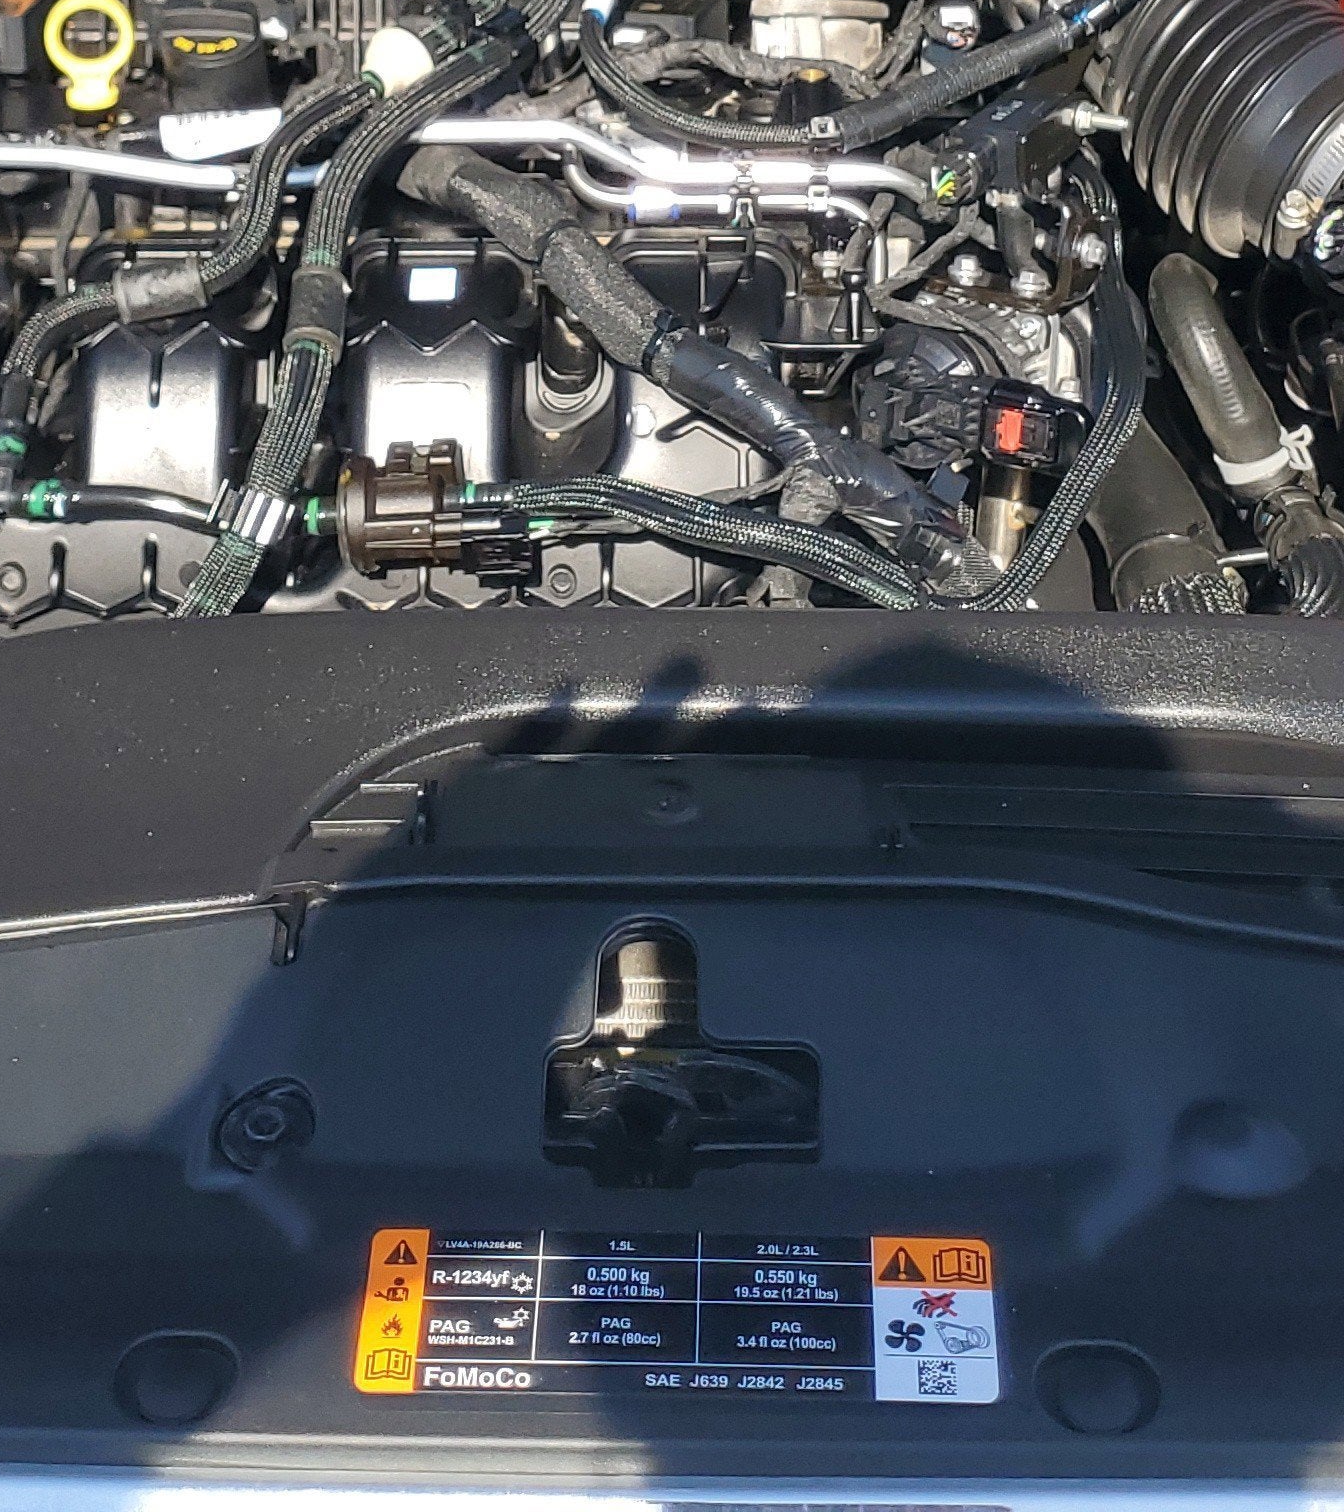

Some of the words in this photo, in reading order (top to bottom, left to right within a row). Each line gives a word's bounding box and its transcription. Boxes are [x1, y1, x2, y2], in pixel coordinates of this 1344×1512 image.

[608, 1240, 637, 1251] 1.5L
[756, 1244, 784, 1255] 2.0L
[792, 1245, 819, 1256] 2.3L
[432, 1269, 511, 1288] R-1234yf
[587, 1267, 627, 1282] 0.500
[631, 1268, 650, 1285] kg
[754, 1269, 795, 1284] 0.550
[798, 1270, 817, 1288] kg
[570, 1284, 586, 1296] 18
[588, 1287, 605, 1296] oz
[607, 1284, 638, 1298] (1.10
[640, 1286, 665, 1299] lbs)
[734, 1286, 760, 1298] 19.5
[763, 1289, 779, 1299] oz
[781, 1287, 811, 1301] (1.21
[815, 1288, 839, 1302] lbs)
[429, 1319, 471, 1334] PAG
[601, 1317, 632, 1329] PAG
[771, 1321, 802, 1334] PAG
[427, 1335, 515, 1346] WSH-M1C231-B
[568, 1331, 589, 1344] 2.7
[591, 1331, 601, 1344] fl
[603, 1334, 620, 1344] oz
[621, 1332, 661, 1347] (80cc)
[736, 1336, 757, 1348] 3.4
[759, 1336, 768, 1348] fl
[770, 1339, 787, 1348] oz
[789, 1336, 836, 1352] (100cc)
[423, 1366, 531, 1388] FoMoCo
[645, 1373, 681, 1388] SAE
[689, 1374, 729, 1388] J639
[737, 1375, 785, 1389] J2842
[795, 1376, 844, 1390] J2845
